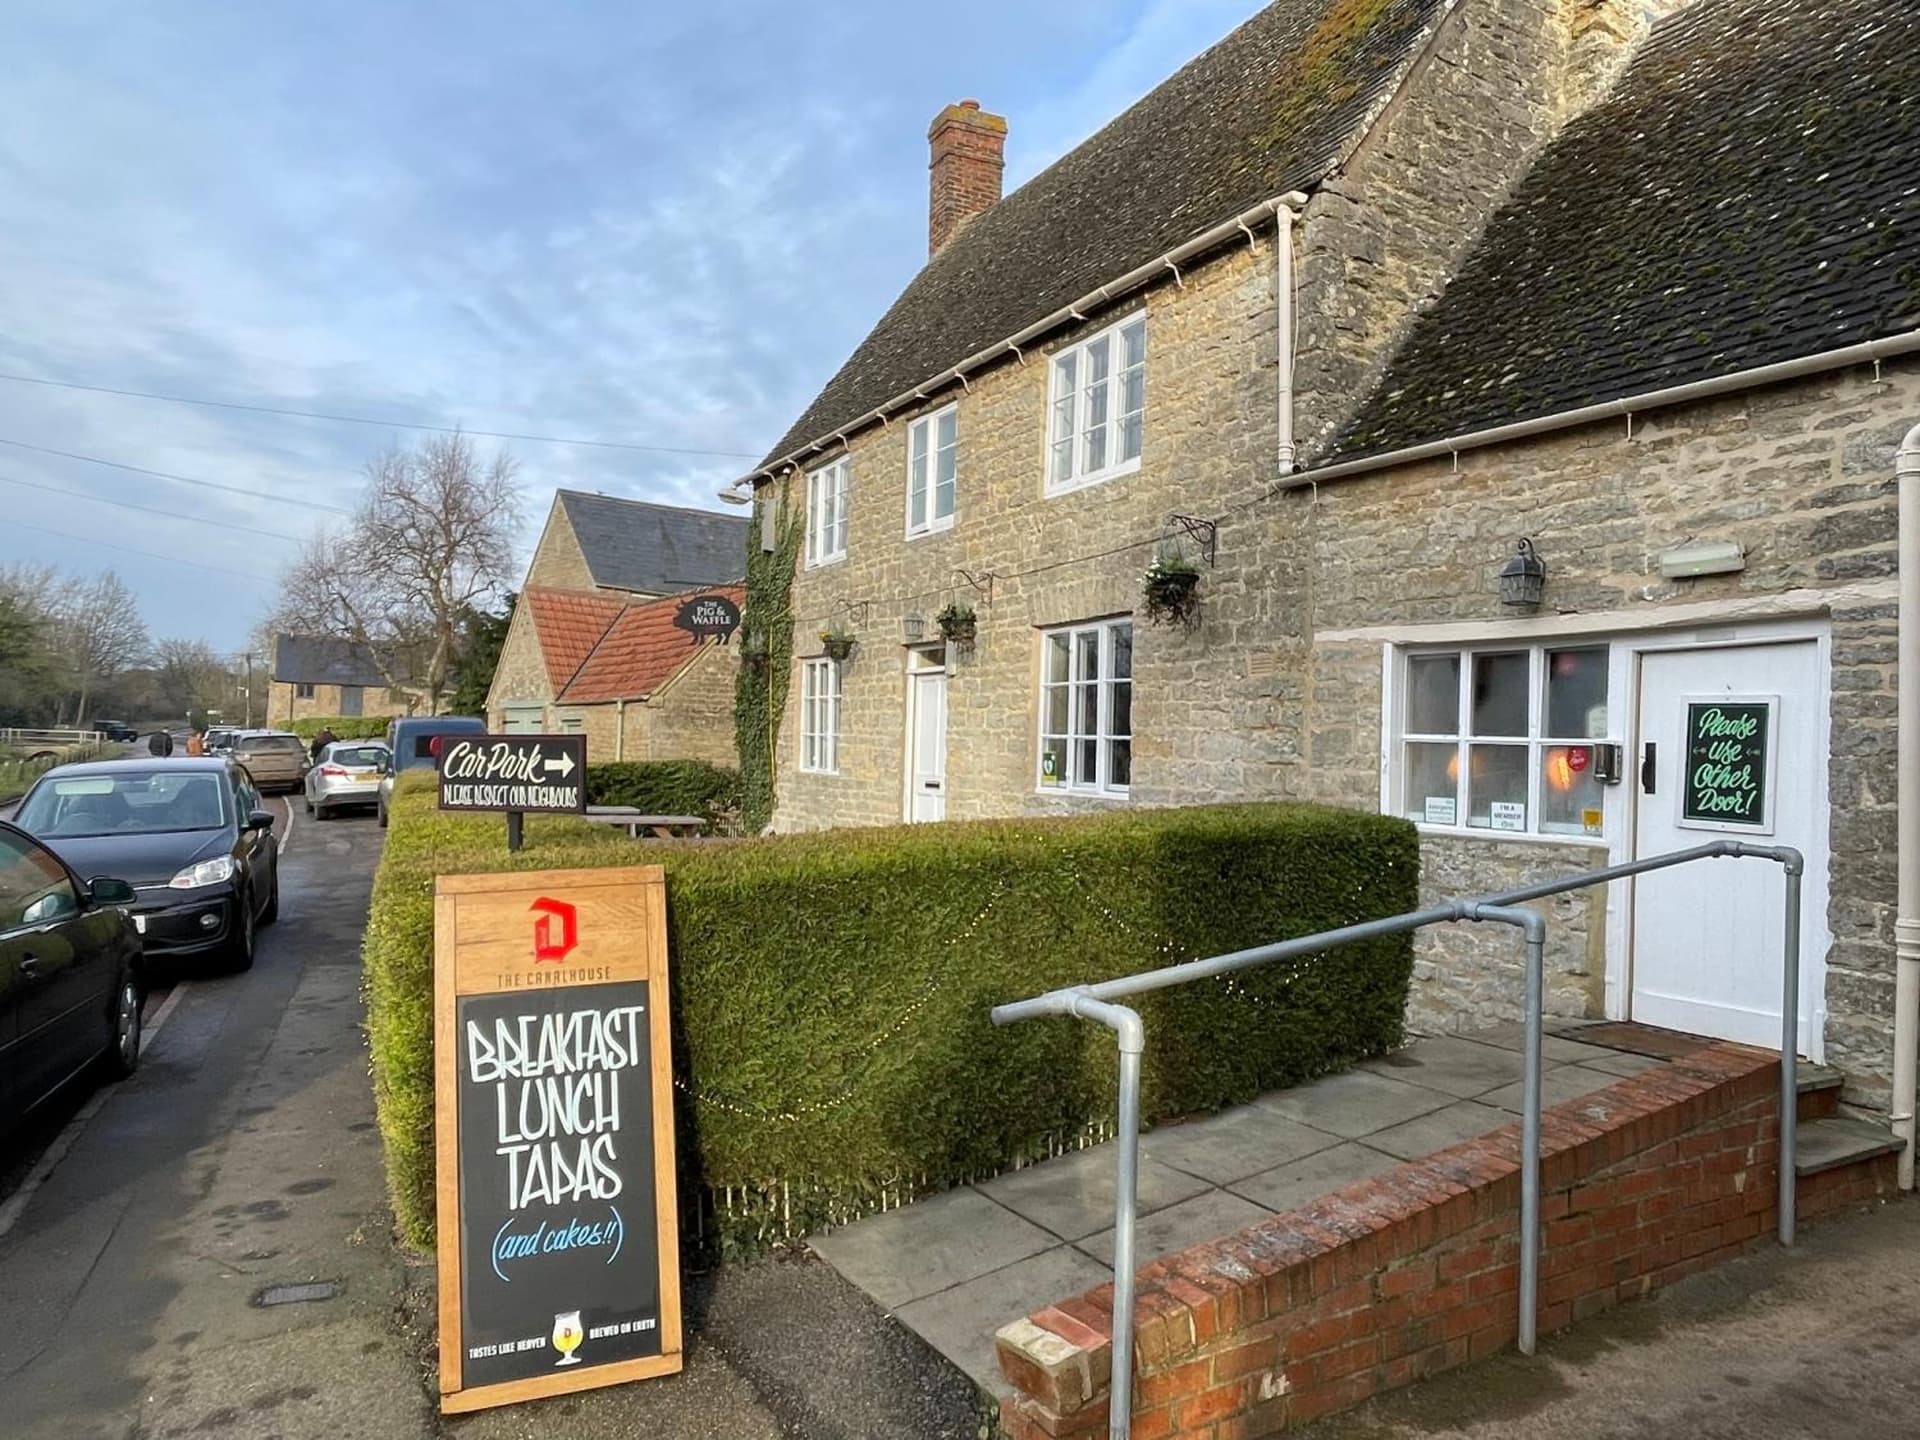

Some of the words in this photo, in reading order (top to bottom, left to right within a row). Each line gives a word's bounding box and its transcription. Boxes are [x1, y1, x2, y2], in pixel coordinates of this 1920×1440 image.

[691, 615, 731, 625] WAFFLE
[697, 606, 715, 616] PIG
[716, 606, 726, 616] &
[1699, 708, 1757, 739] Please
[444, 741, 486, 779] Car
[485, 742, 546, 783] Park
[1694, 763, 1756, 790] Other
[443, 784, 473, 805] PLEASE
[474, 784, 509, 806] RESPECT
[509, 785, 527, 806] OUR
[527, 785, 578, 808] NEIGHBOURS
[1697, 788, 1757, 815] Door!
[498, 973, 522, 988] THE
[526, 966, 611, 985] CANALHOUSE
[467, 1006, 645, 1082] BREAKFAST
[497, 1070, 620, 1143] LUNCH
[496, 1133, 622, 1210] TAPAS
[469, 1345, 497, 1360] TASTES
[499, 1341, 515, 1356] LIKE
[517, 1336, 546, 1351] HEAVEN
[589, 1325, 619, 1340] BREWED
[620, 1322, 632, 1334] ON
[633, 1318, 656, 1333] EARTH
